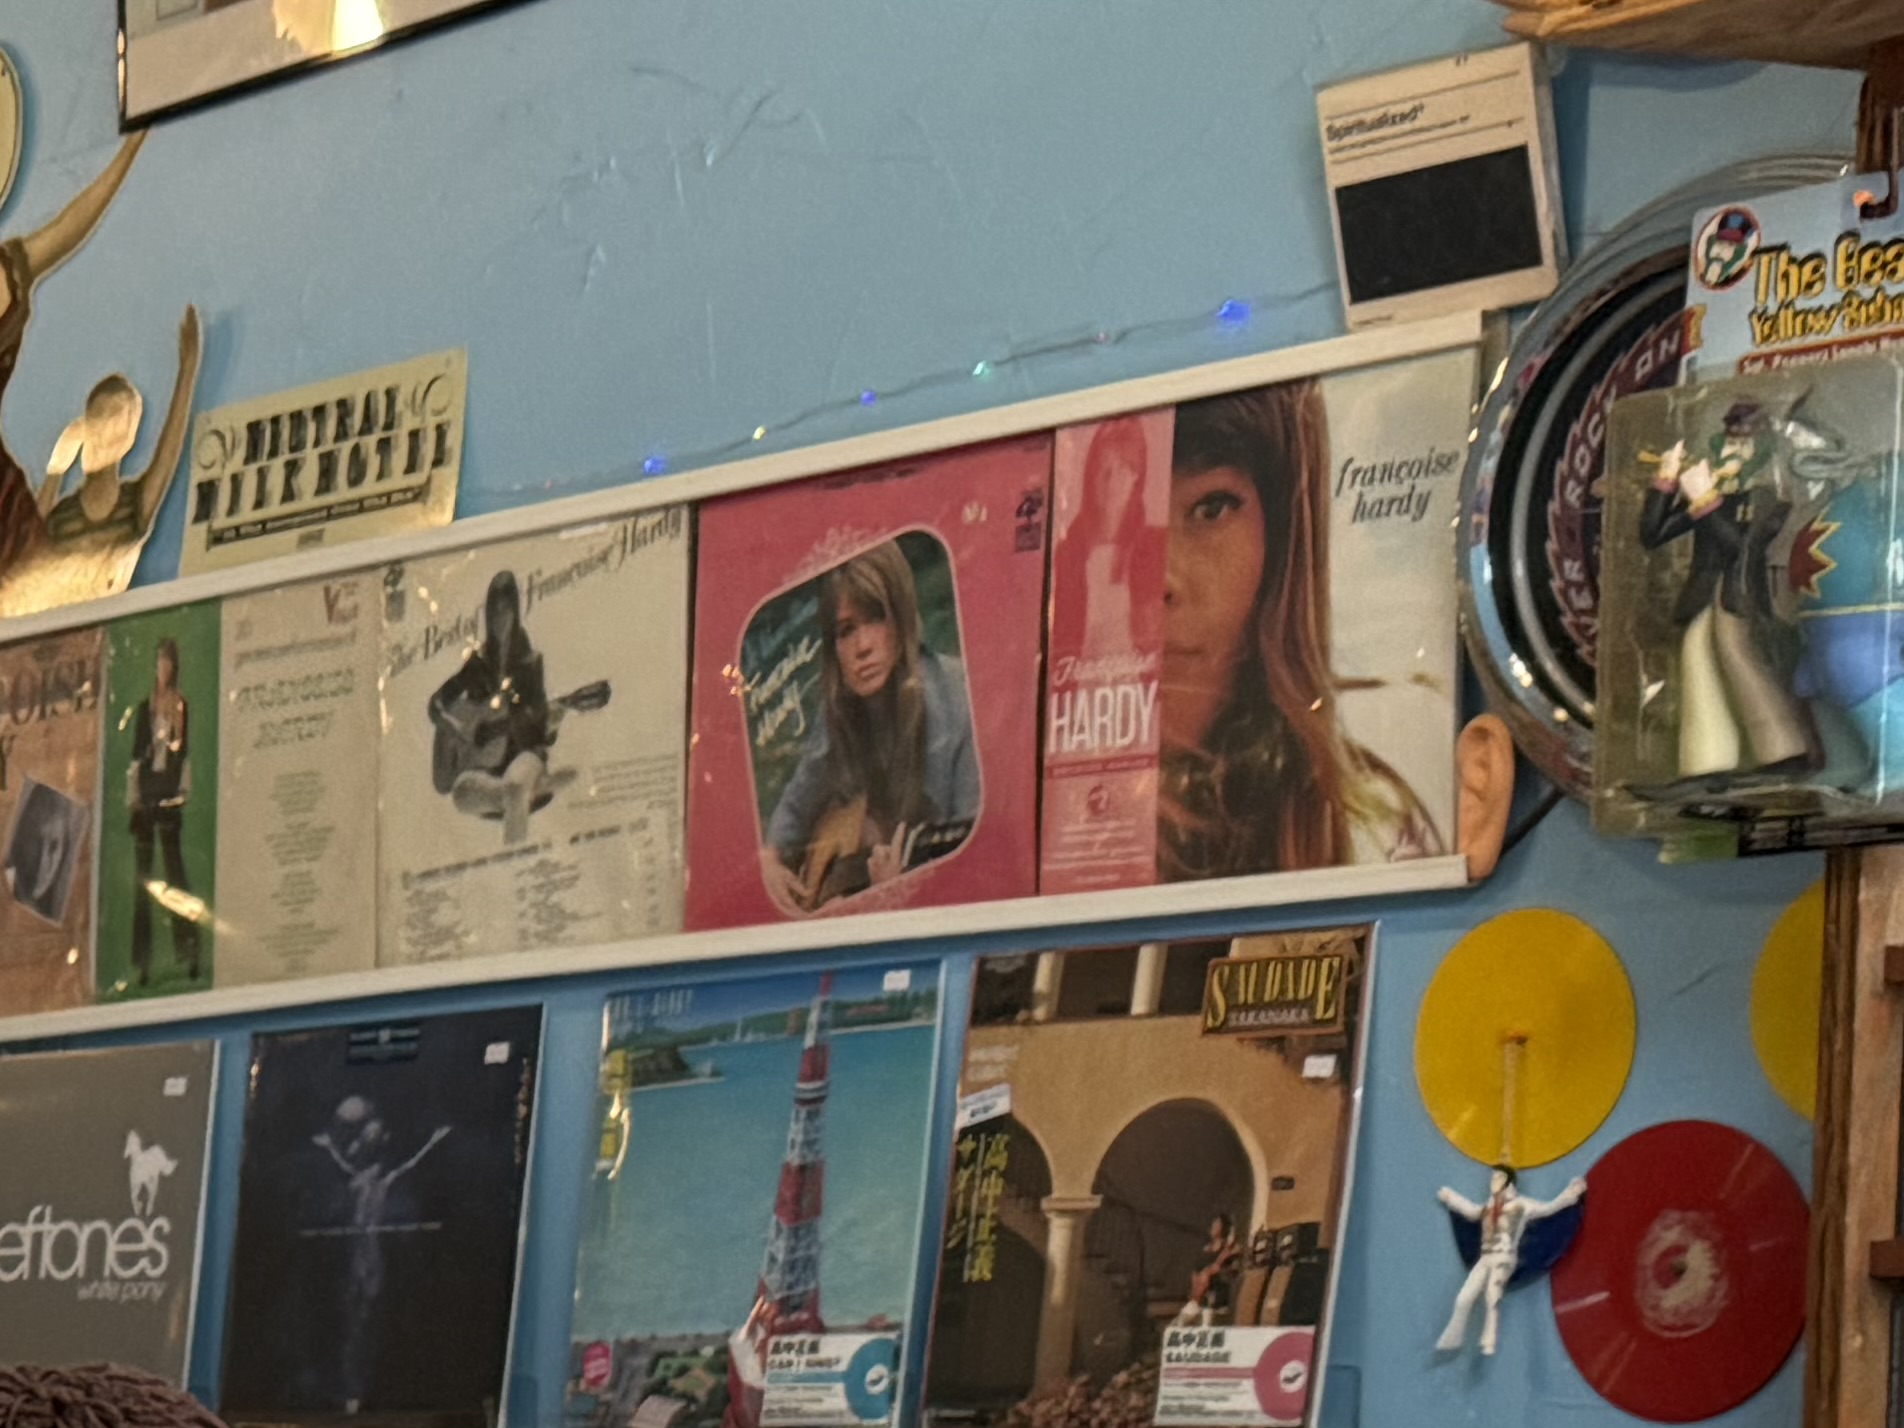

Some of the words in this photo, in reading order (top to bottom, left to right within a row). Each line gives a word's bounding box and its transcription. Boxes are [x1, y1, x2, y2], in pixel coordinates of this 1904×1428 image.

[1752, 240, 1828, 306] The
[1351, 483, 1432, 524] hardy
[1048, 678, 1159, 754] HARDY
[1205, 954, 1341, 1028] SAUDADE
[77, 1281, 121, 1301] white
[121, 1281, 168, 1303] pony
